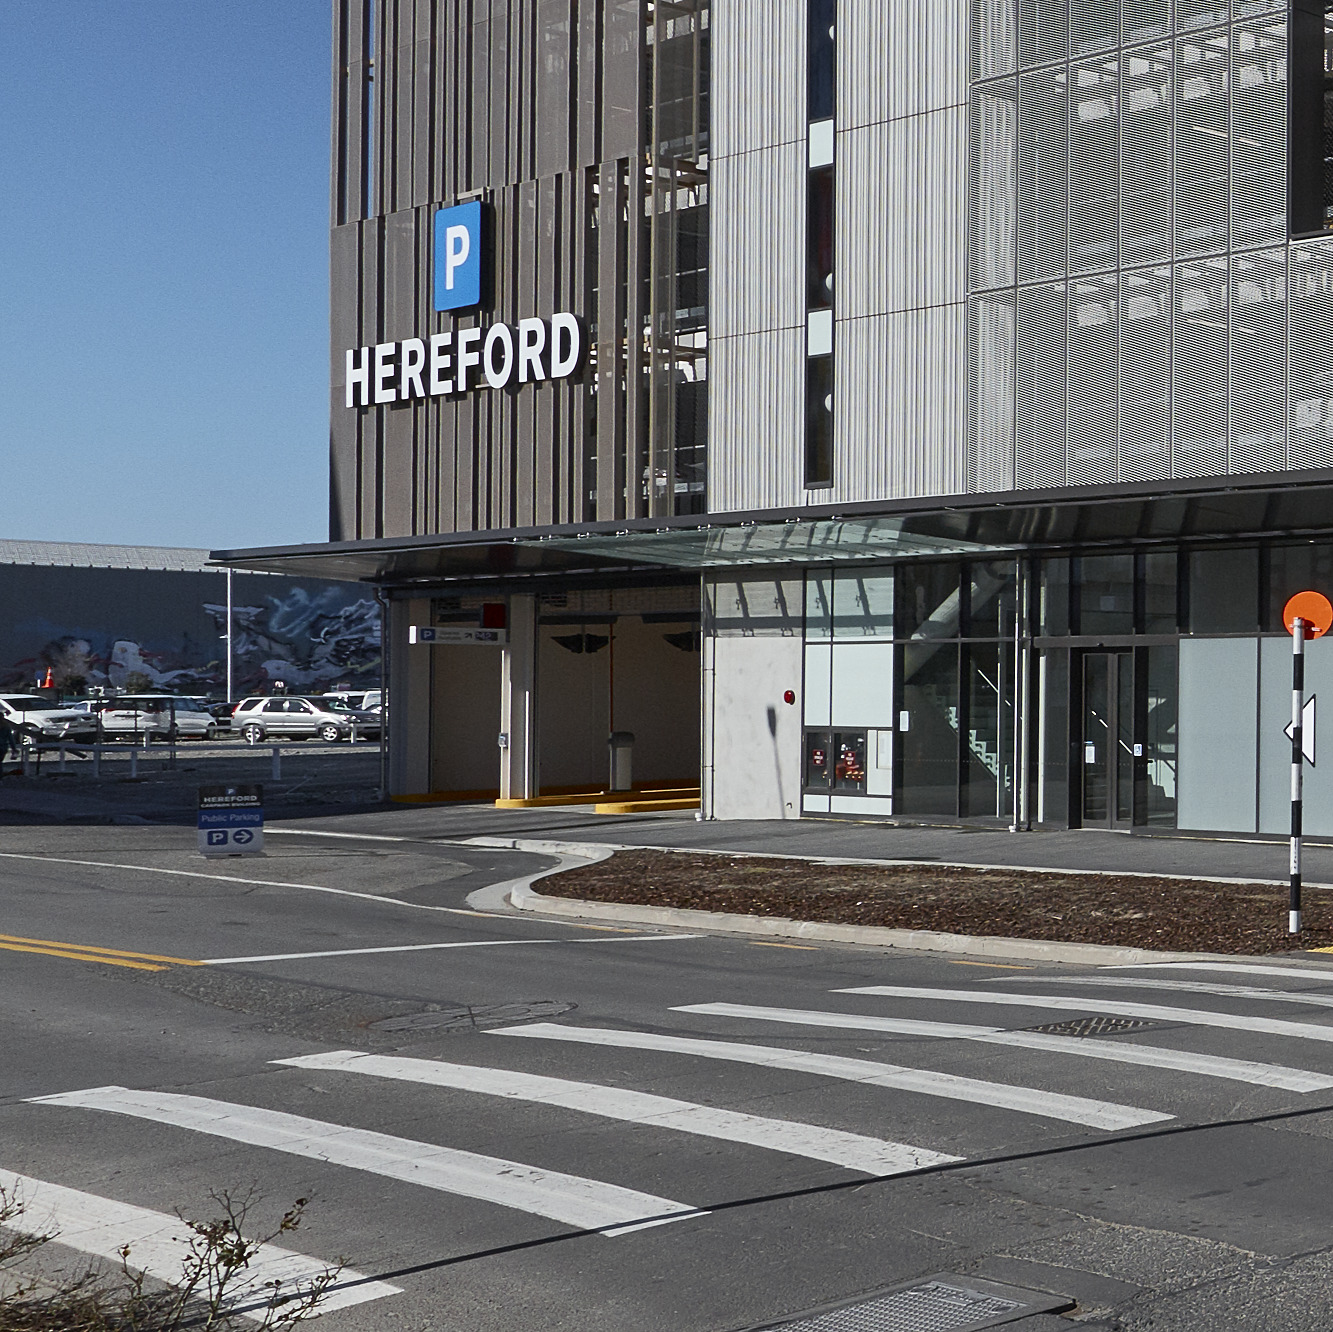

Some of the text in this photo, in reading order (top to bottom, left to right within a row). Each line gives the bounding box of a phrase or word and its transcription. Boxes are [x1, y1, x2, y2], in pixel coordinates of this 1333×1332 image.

[446, 225, 470, 290] P
[346, 312, 580, 408] HEREFORD
[212, 833, 223, 843] P
